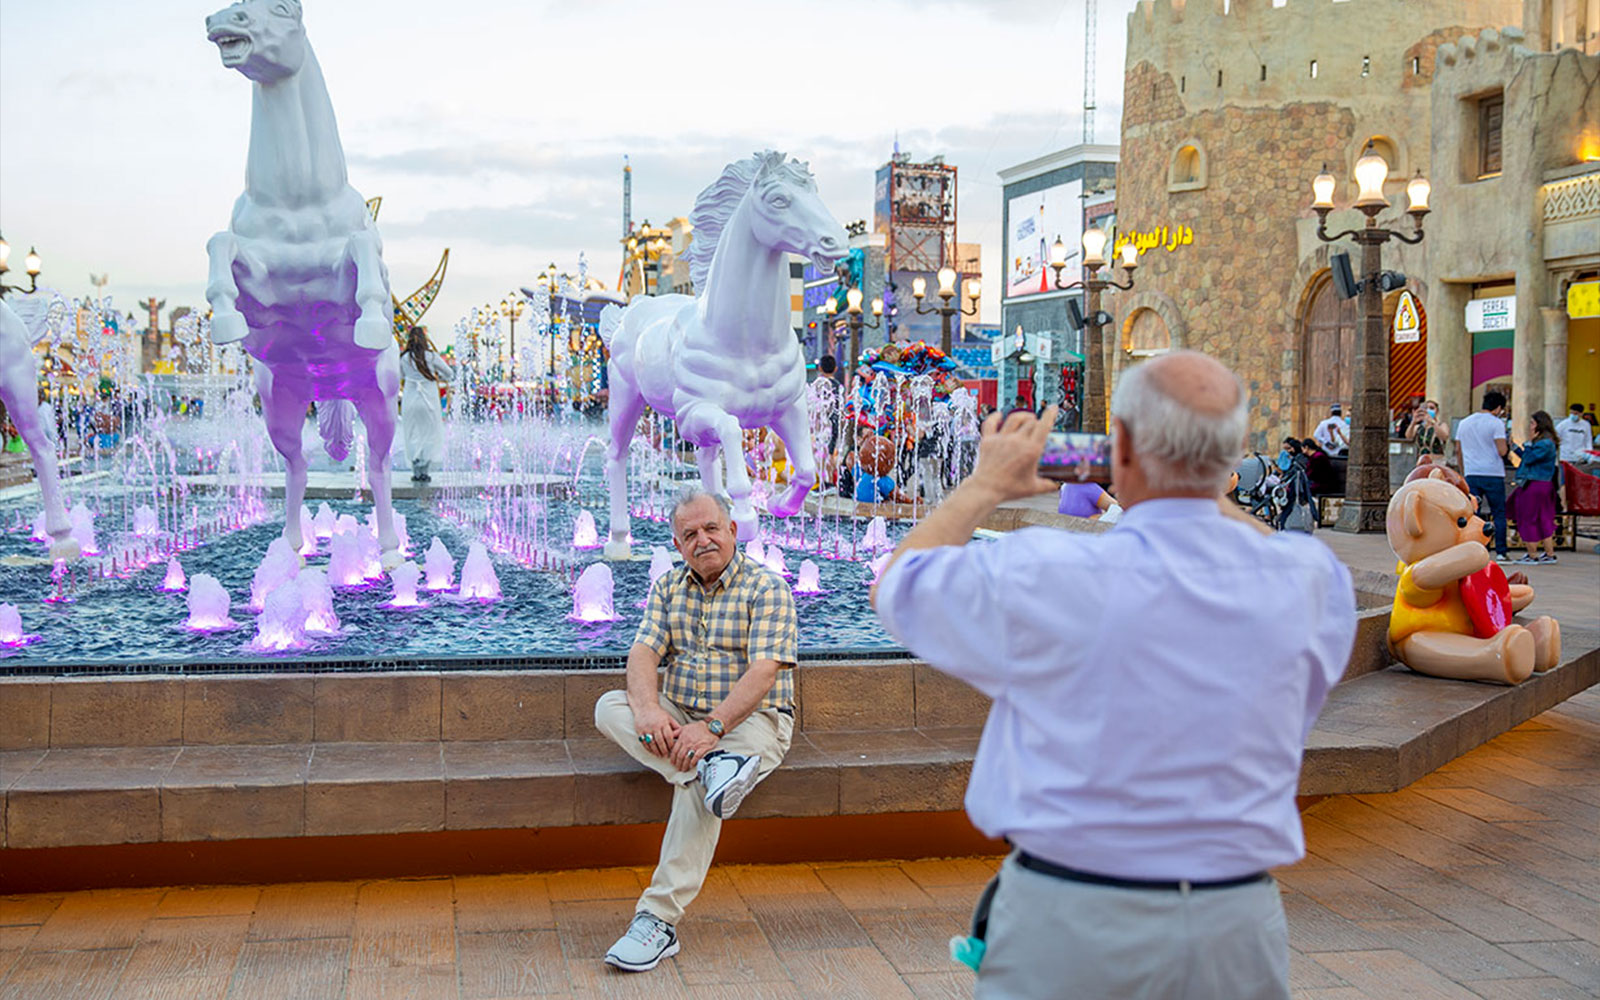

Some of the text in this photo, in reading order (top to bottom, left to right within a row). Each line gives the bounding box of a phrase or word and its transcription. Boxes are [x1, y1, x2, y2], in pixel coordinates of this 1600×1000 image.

[1166, 224, 1193, 252] دار
[1483, 300, 1508, 312] CEREAL
[1483, 317, 1508, 329] SOCIETY
